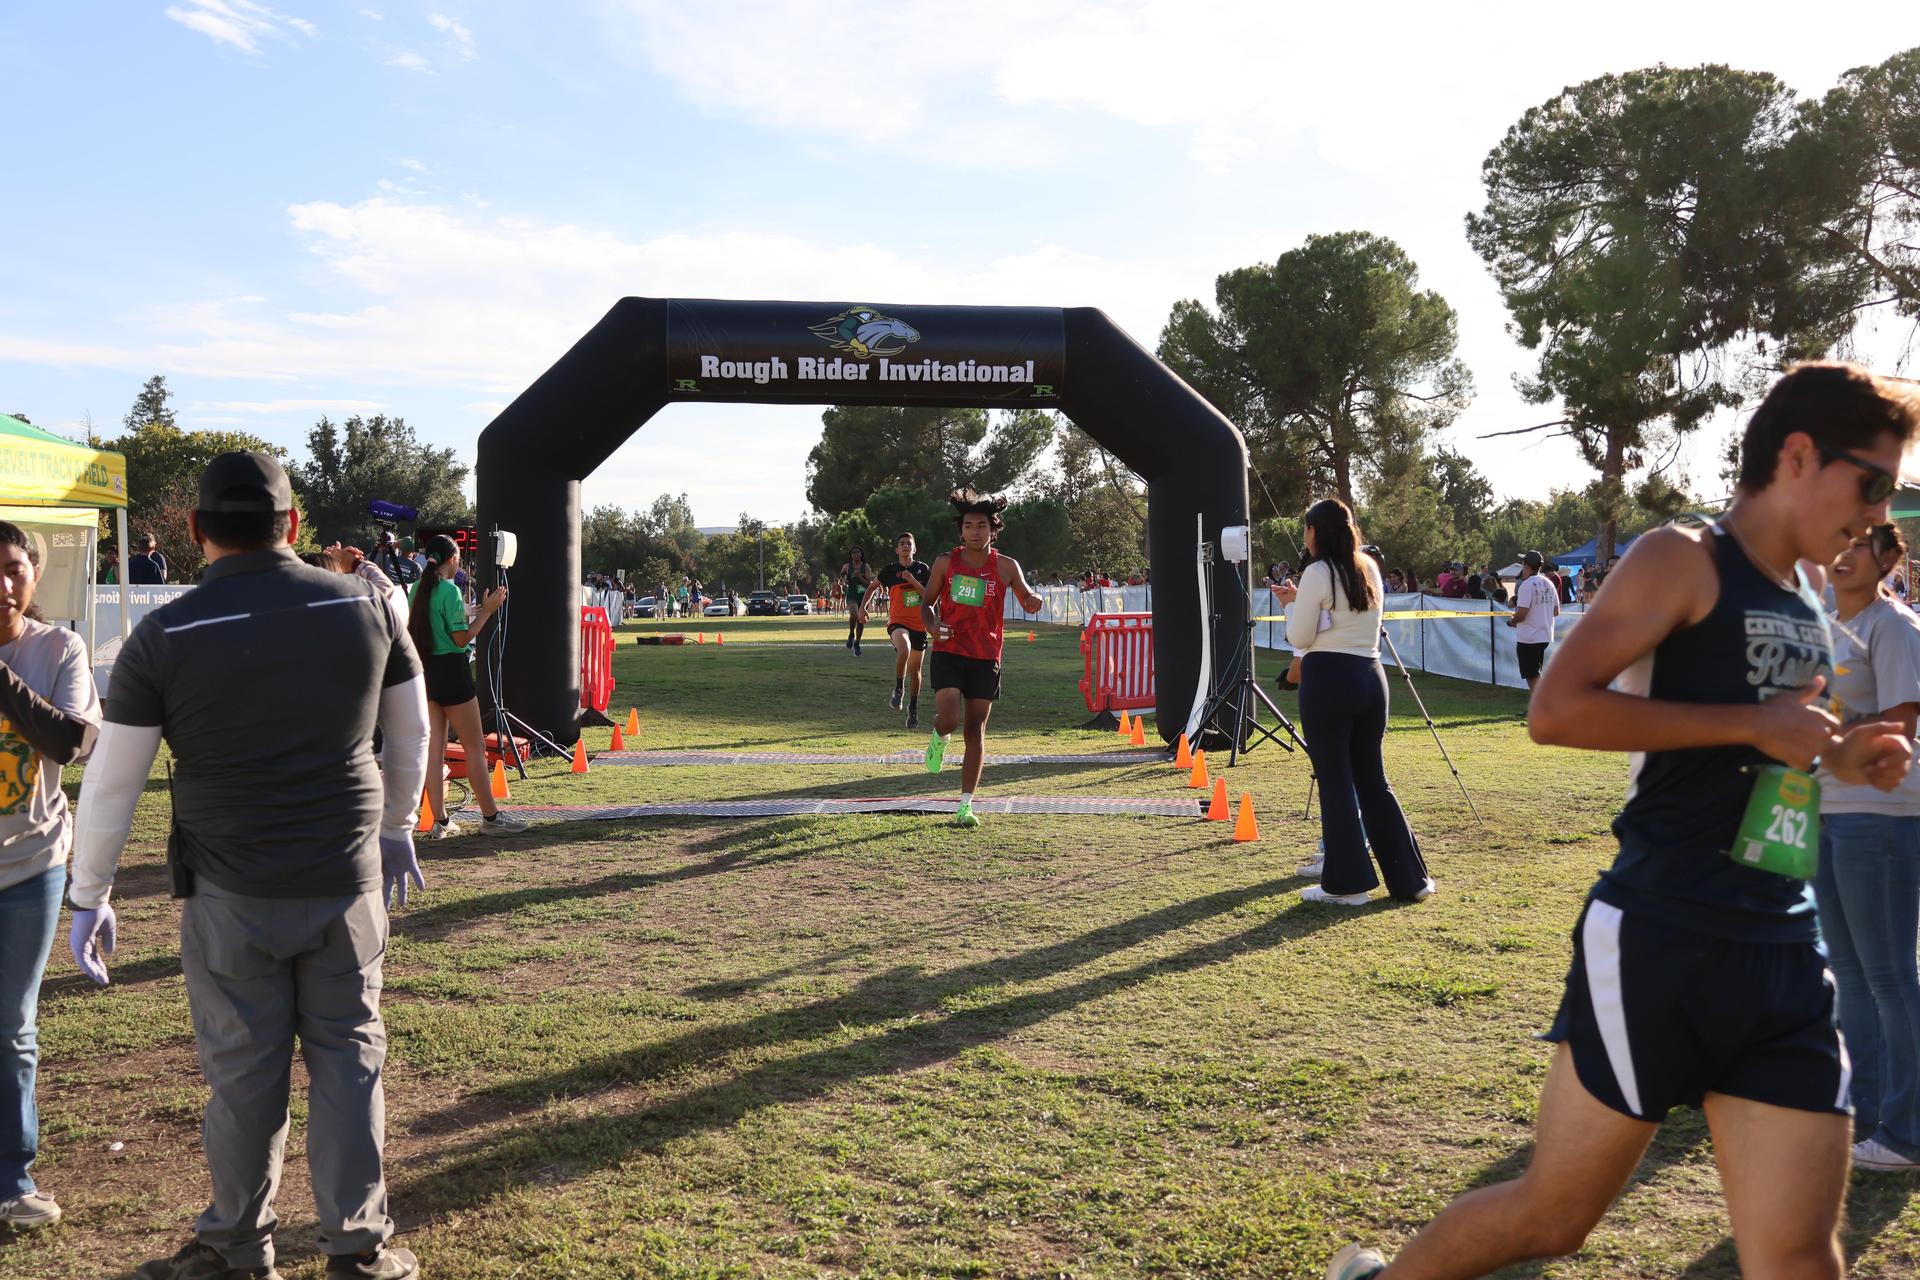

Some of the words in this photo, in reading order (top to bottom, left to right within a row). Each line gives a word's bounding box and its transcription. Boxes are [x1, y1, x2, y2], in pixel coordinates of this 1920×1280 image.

[700, 355, 788, 384] Rough
[797, 357, 870, 381] Rider
[879, 358, 1035, 383] Invitational
[675, 379, 696, 389] R
[1033, 385, 1054, 394] R
[83, 461, 109, 488] FIELD
[958, 585, 976, 599] 291
[1765, 804, 1808, 849] 262
